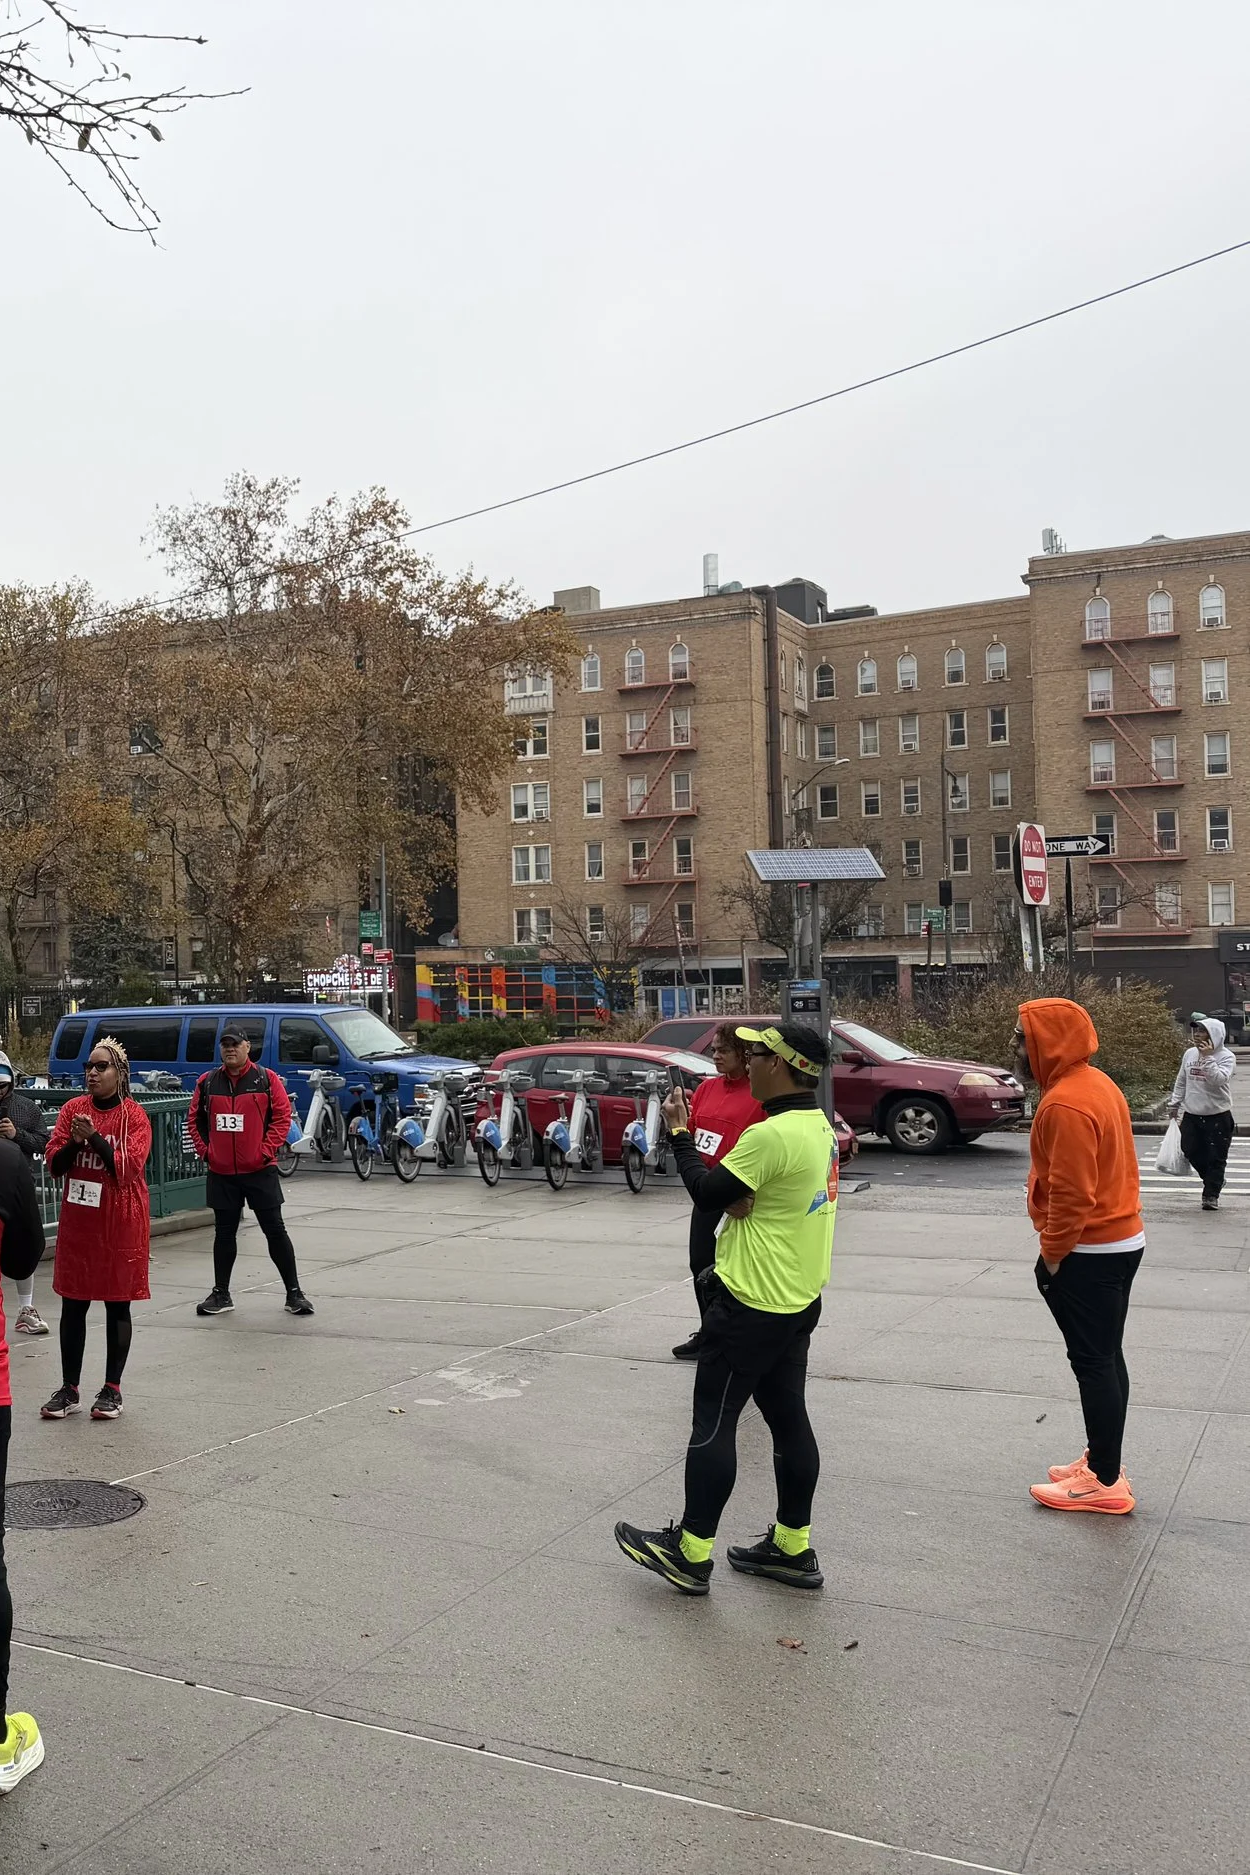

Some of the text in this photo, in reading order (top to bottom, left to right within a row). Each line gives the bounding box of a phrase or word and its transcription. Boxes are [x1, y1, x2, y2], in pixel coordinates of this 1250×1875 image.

[1024, 840, 1041, 853] DO NOT
[1045, 841, 1098, 852] ONE WAY
[1029, 875, 1043, 888] ENTER
[222, 1116, 237, 1129] 13
[696, 1133, 713, 1149] 15
[78, 1184, 86, 1201] 1
